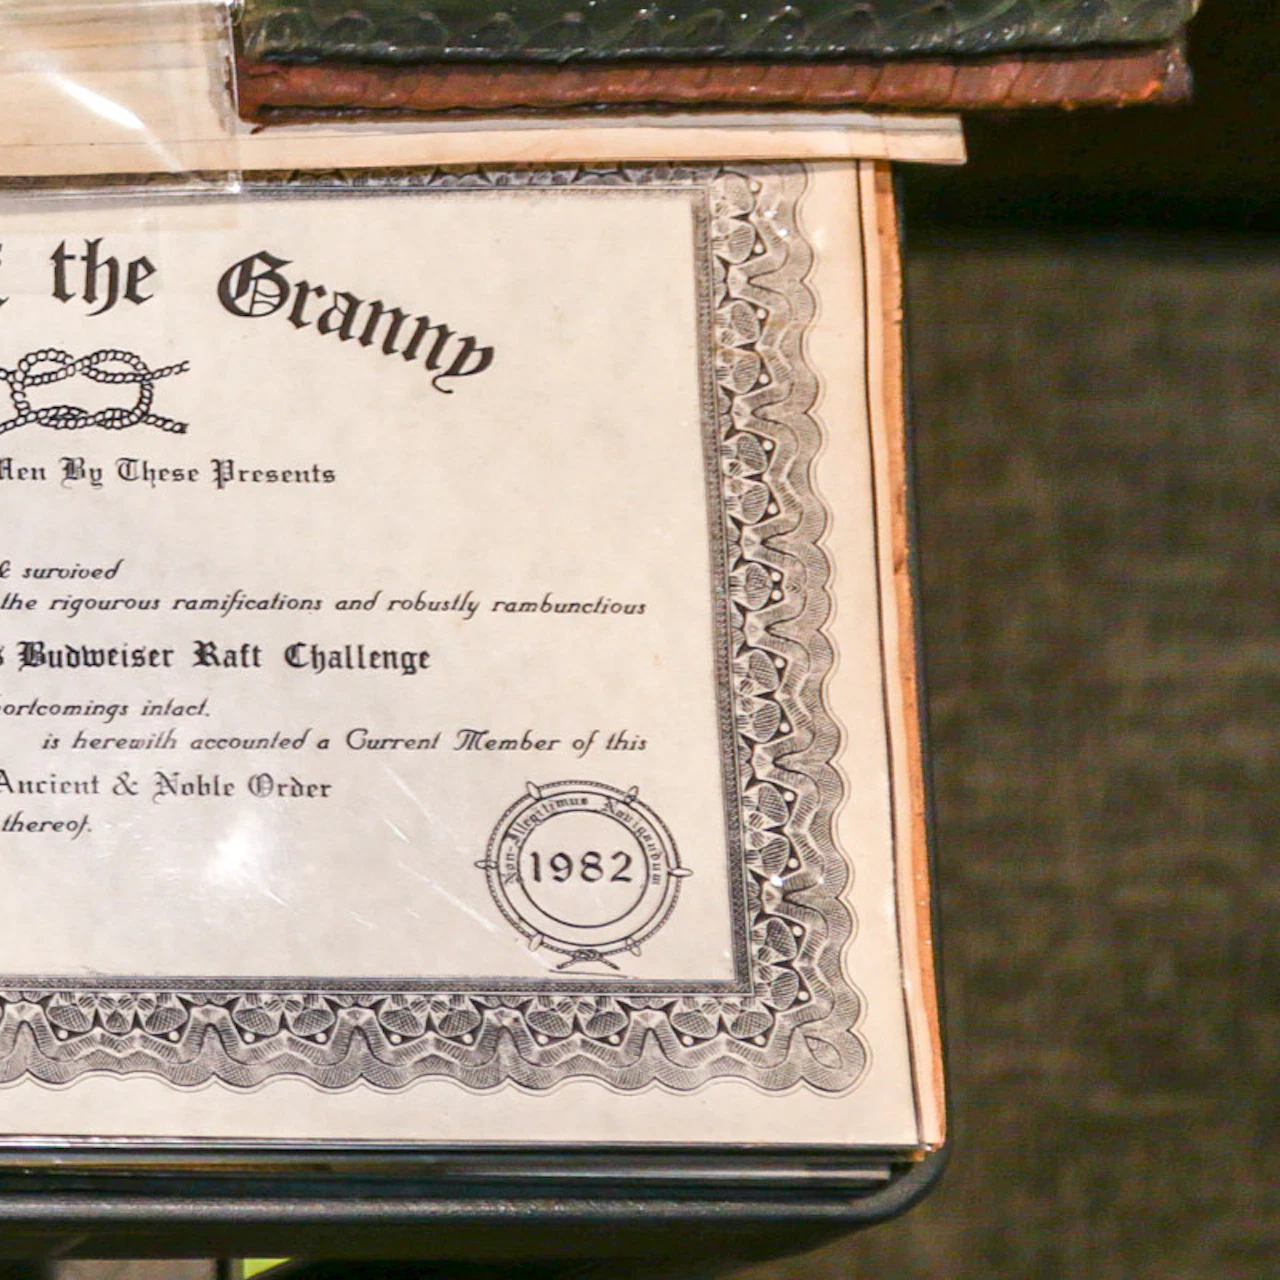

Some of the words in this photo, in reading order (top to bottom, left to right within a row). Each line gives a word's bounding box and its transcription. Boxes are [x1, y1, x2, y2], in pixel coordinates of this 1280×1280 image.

[50, 237, 157, 317] the
[217, 248, 495, 394] Granny
[59, 455, 104, 489] By
[116, 457, 199, 489] These
[210, 458, 335, 489] Presents
[22, 557, 124, 580] survived
[0, 592, 37, 611] the
[49, 594, 160, 618] rigourous
[172, 588, 322, 618] ramifications
[335, 589, 382, 612] and
[387, 589, 479, 621] robustly
[491, 592, 646, 615] rambunctious
[17, 640, 174, 673] Budweiser
[192, 639, 262, 669] Raft
[284, 641, 430, 676] Challenge
[141, 698, 210, 719] intact.
[42, 733, 60, 750] is
[72, 727, 176, 750] herewith
[190, 727, 312, 750] accounted
[316, 738, 331, 750] a
[346, 727, 441, 751] Current
[453, 728, 561, 751] Member
[572, 729, 600, 758] of
[606, 729, 648, 751] this
[112, 770, 138, 796] &
[152, 770, 234, 803] Noble
[248, 772, 332, 799] Order
[1, 810, 92, 841] thereof.
[530, 850, 633, 884] 1982
